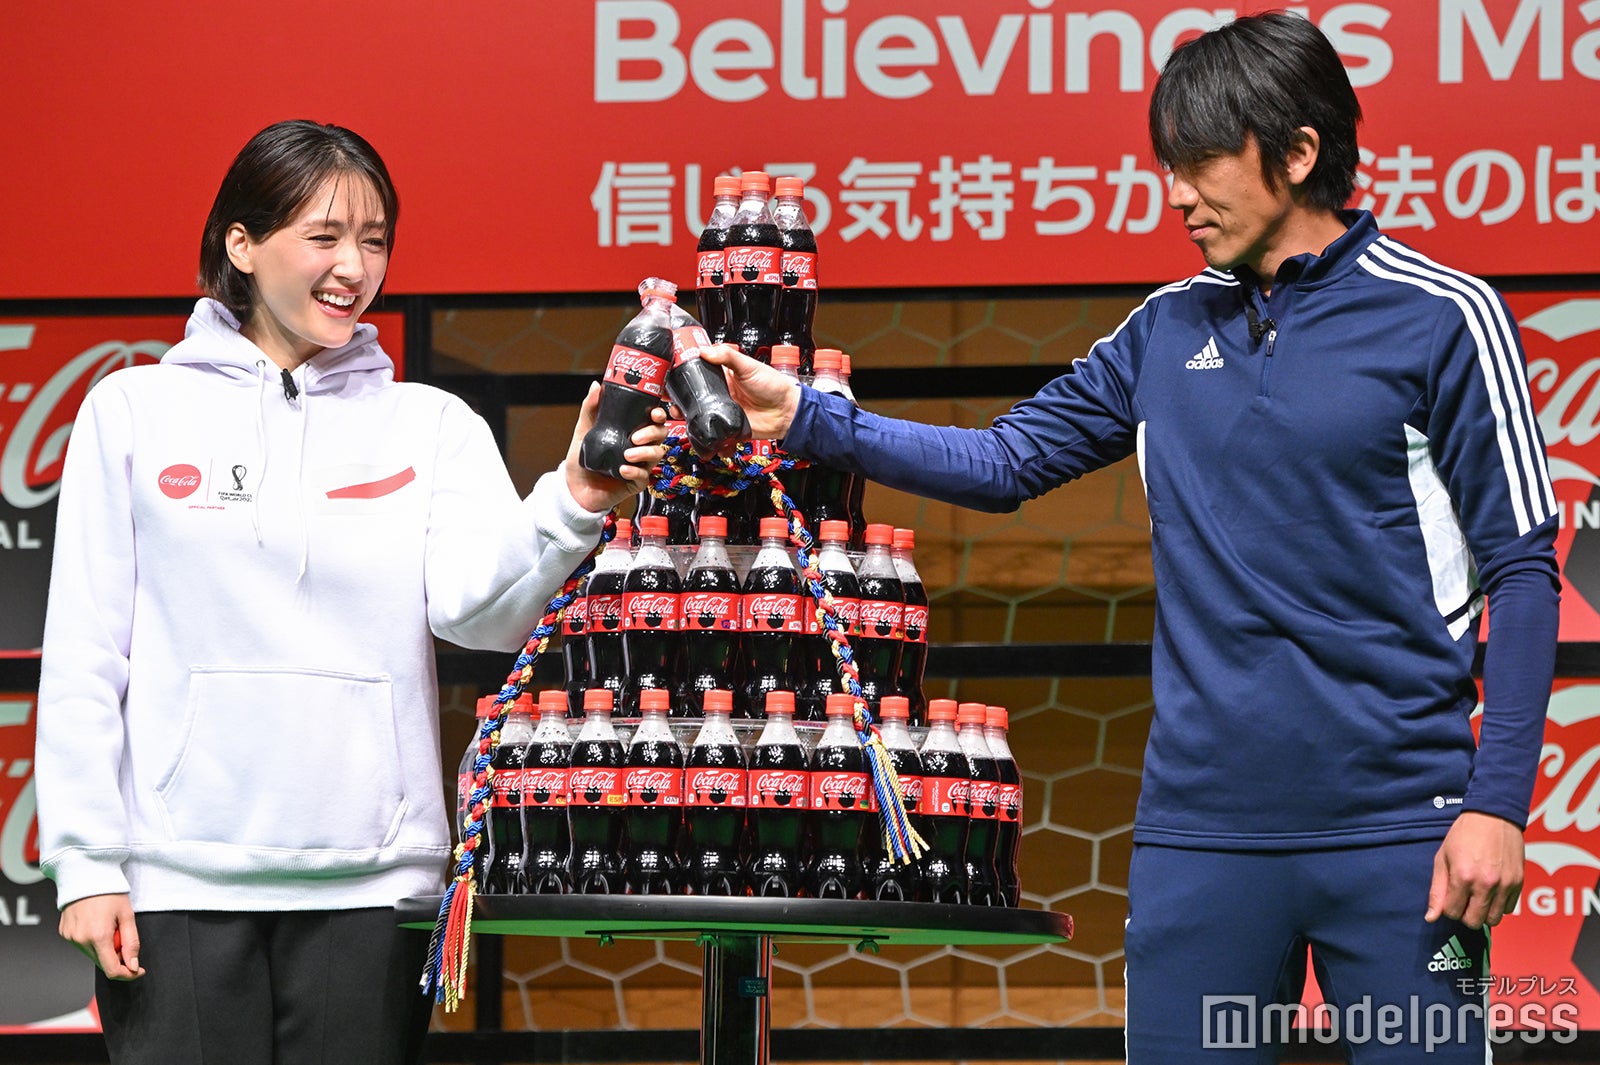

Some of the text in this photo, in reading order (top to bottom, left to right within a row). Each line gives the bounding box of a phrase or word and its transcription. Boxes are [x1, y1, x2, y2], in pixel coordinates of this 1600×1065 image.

[727, 250, 774, 269] Coca-Cola
[613, 349, 662, 378] Coca-Cola
[160, 474, 200, 487] Coca-Cola
[628, 596, 676, 614] Coca-Cola
[683, 596, 731, 614] Coca-Cola
[749, 597, 797, 615] Coca-Cola
[569, 771, 617, 789] Coca-Cola
[625, 771, 673, 789] Coca-Cola
[692, 771, 740, 790] Coca-Cola
[756, 773, 804, 792] Coca-Cola
[820, 775, 867, 794] Coca-Cola
[1427, 957, 1473, 973] adidas
